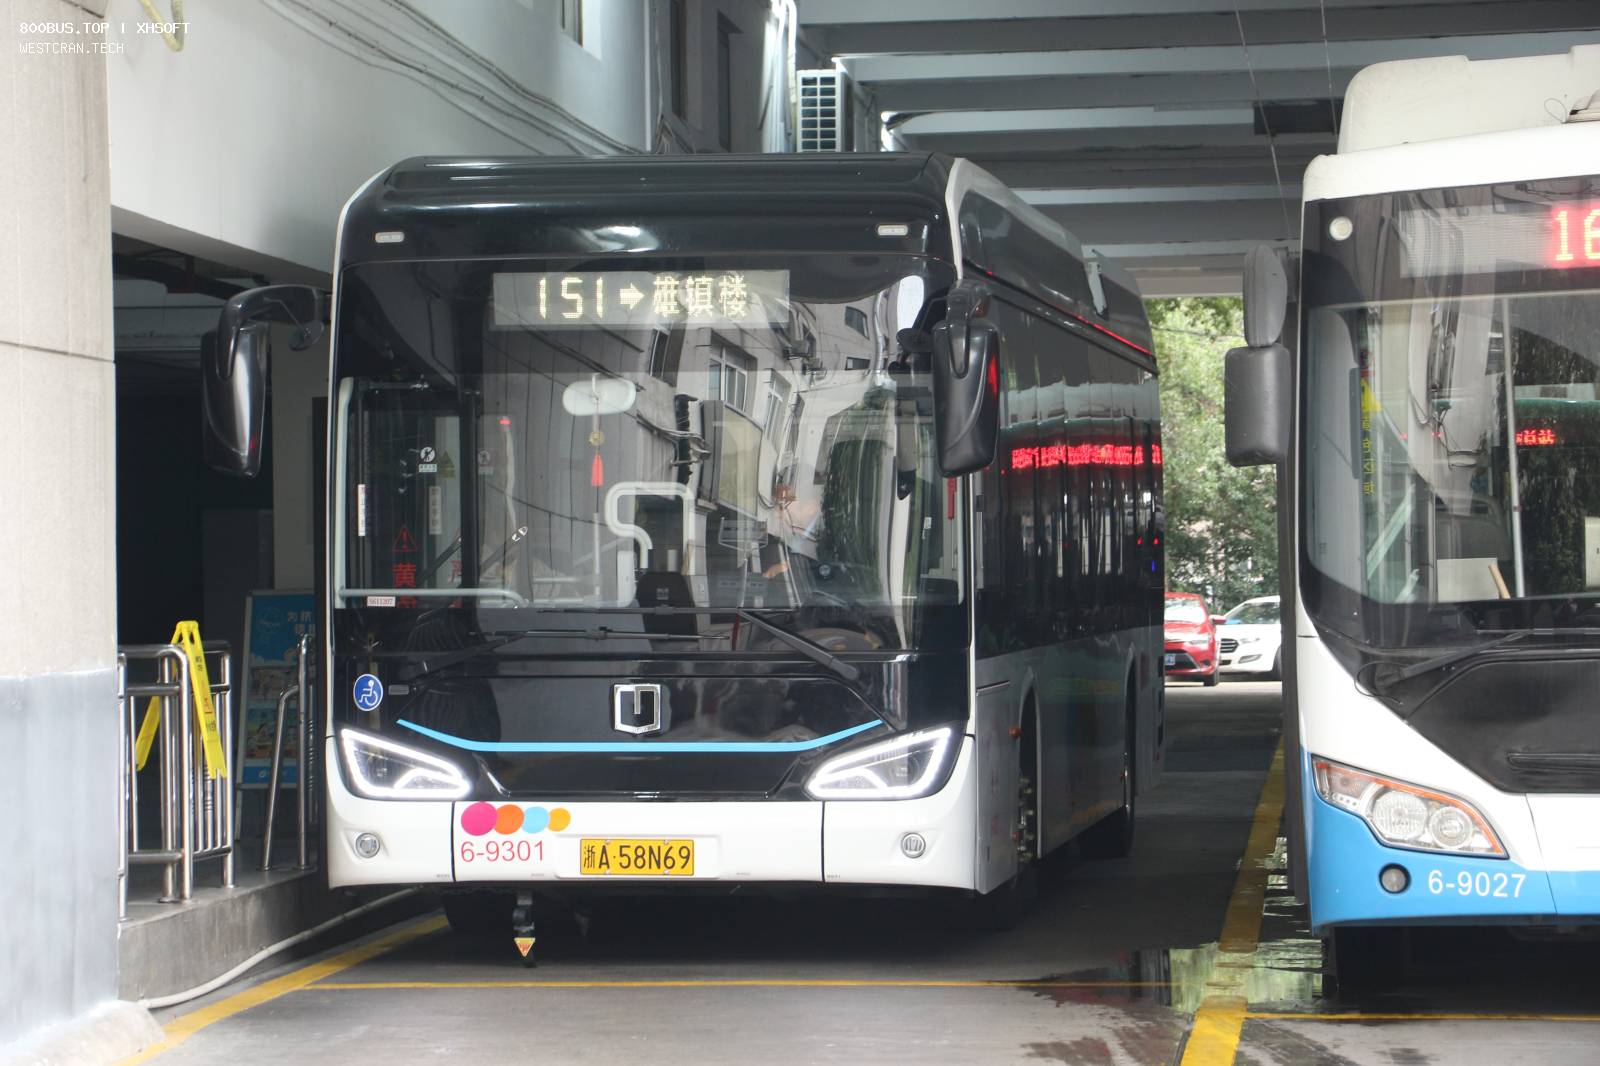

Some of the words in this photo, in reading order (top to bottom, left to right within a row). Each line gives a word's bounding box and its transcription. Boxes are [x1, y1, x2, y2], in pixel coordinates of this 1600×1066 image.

[539, 276, 604, 319] 151
[460, 840, 544, 862] 6-9301
[1427, 869, 1527, 898] 6-9027
